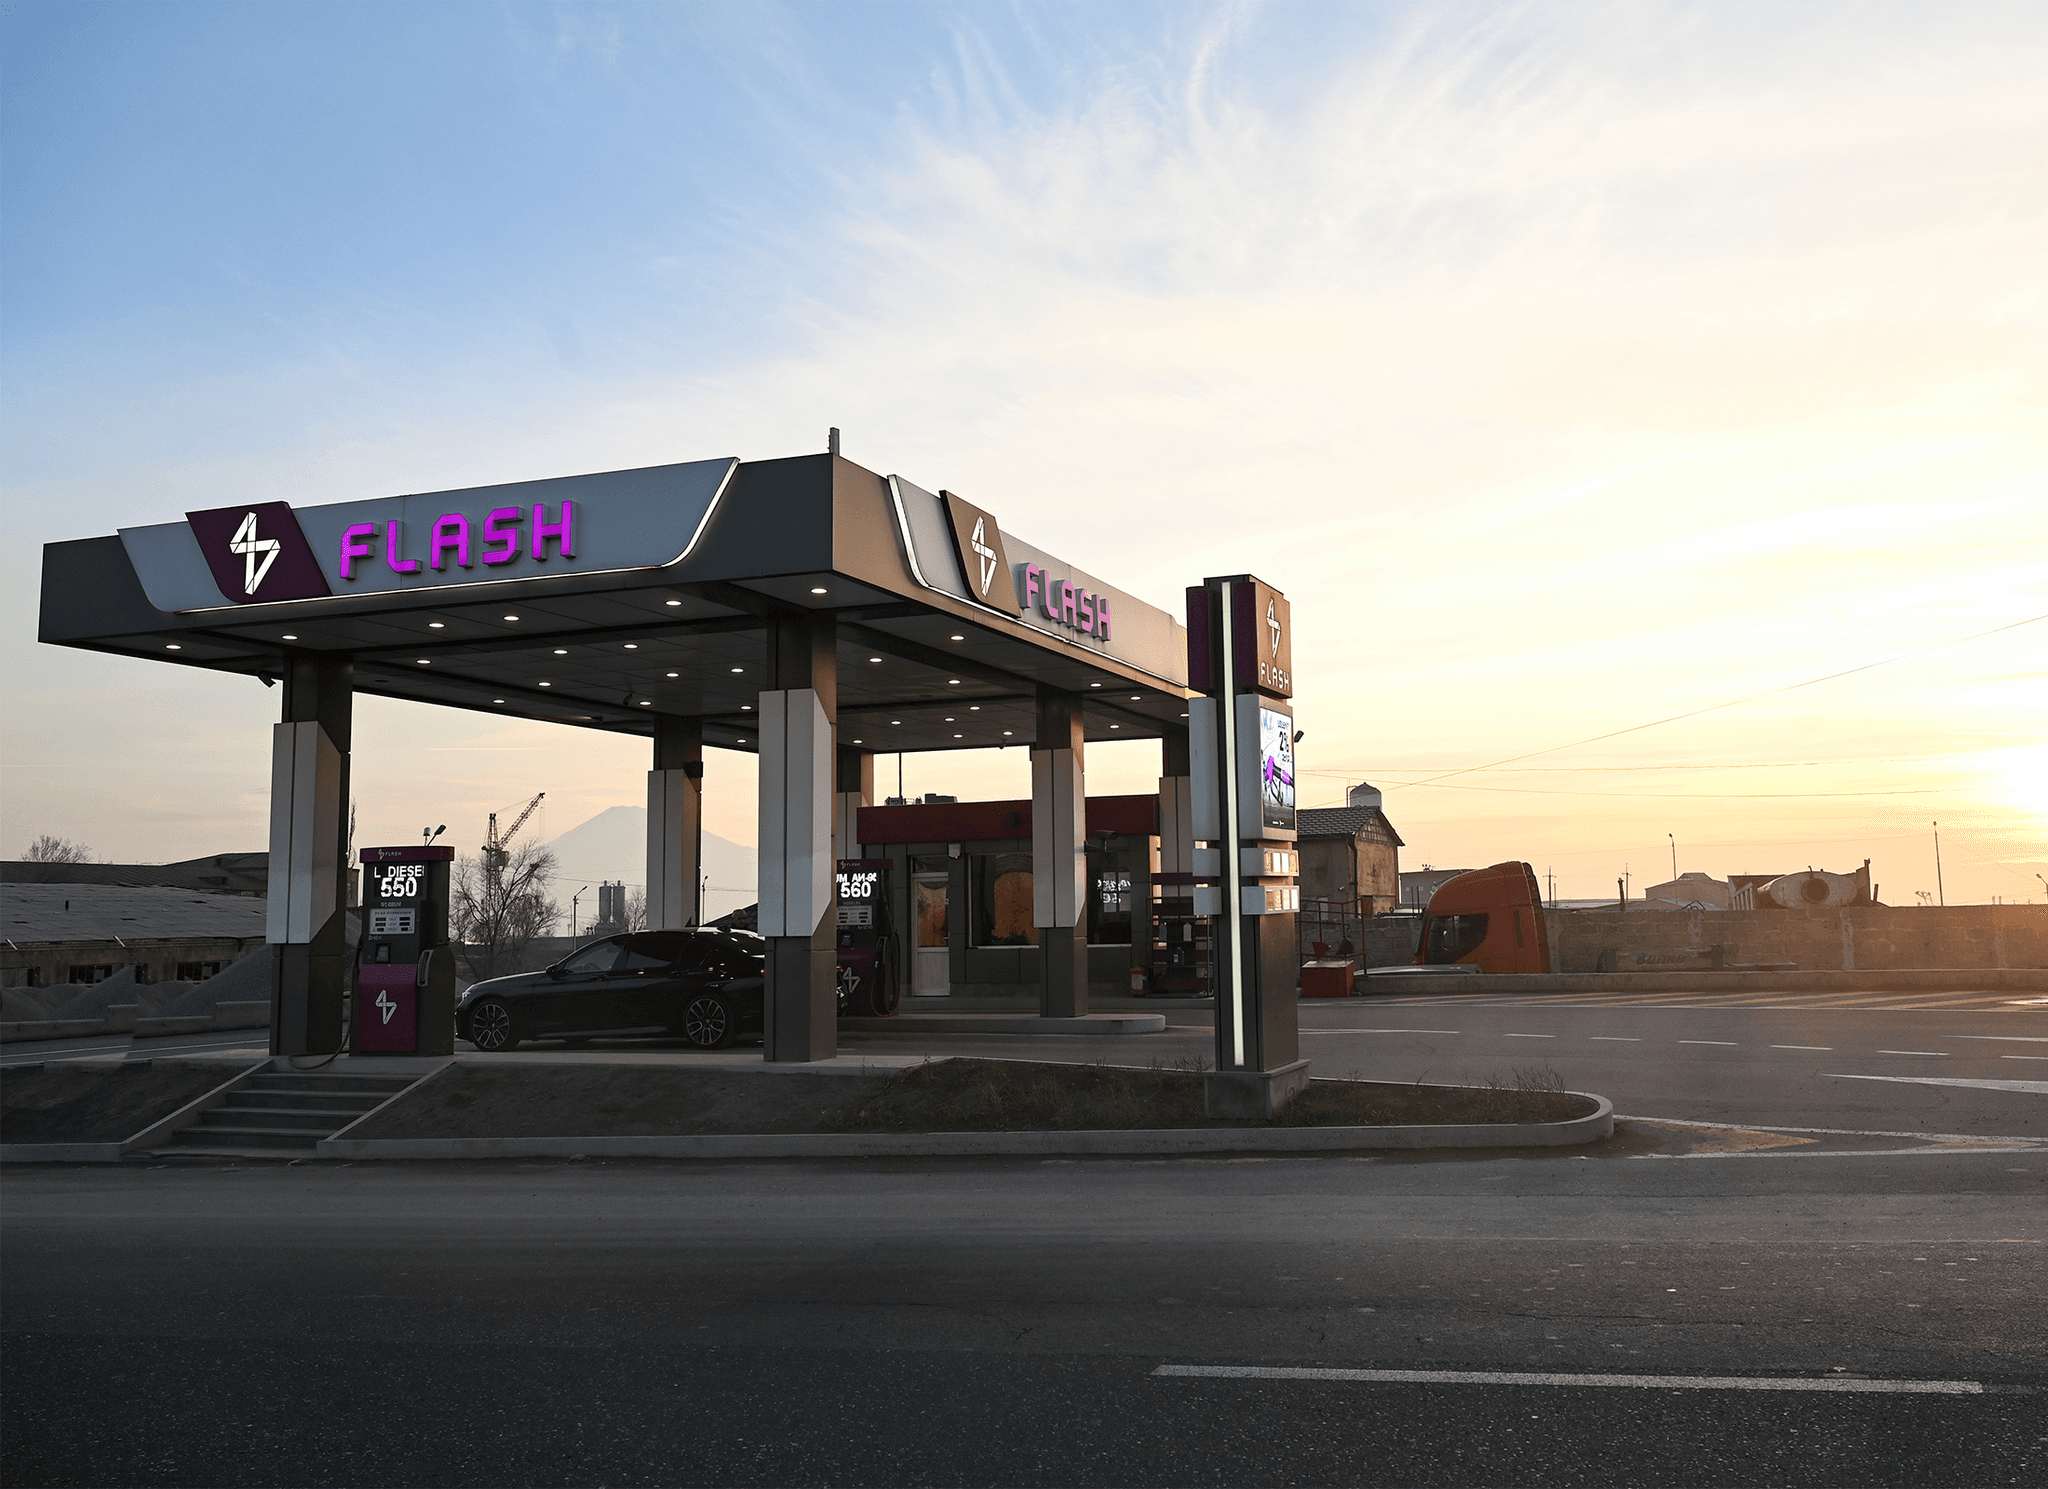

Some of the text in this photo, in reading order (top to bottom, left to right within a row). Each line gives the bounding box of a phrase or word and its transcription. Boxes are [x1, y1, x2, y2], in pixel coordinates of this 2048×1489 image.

[339, 500, 578, 581] FLASH
[1020, 562, 1112, 642] FLASH
[1260, 661, 1290, 692] FLASH
[380, 877, 417, 897] 550
[840, 882, 871, 897] 560
